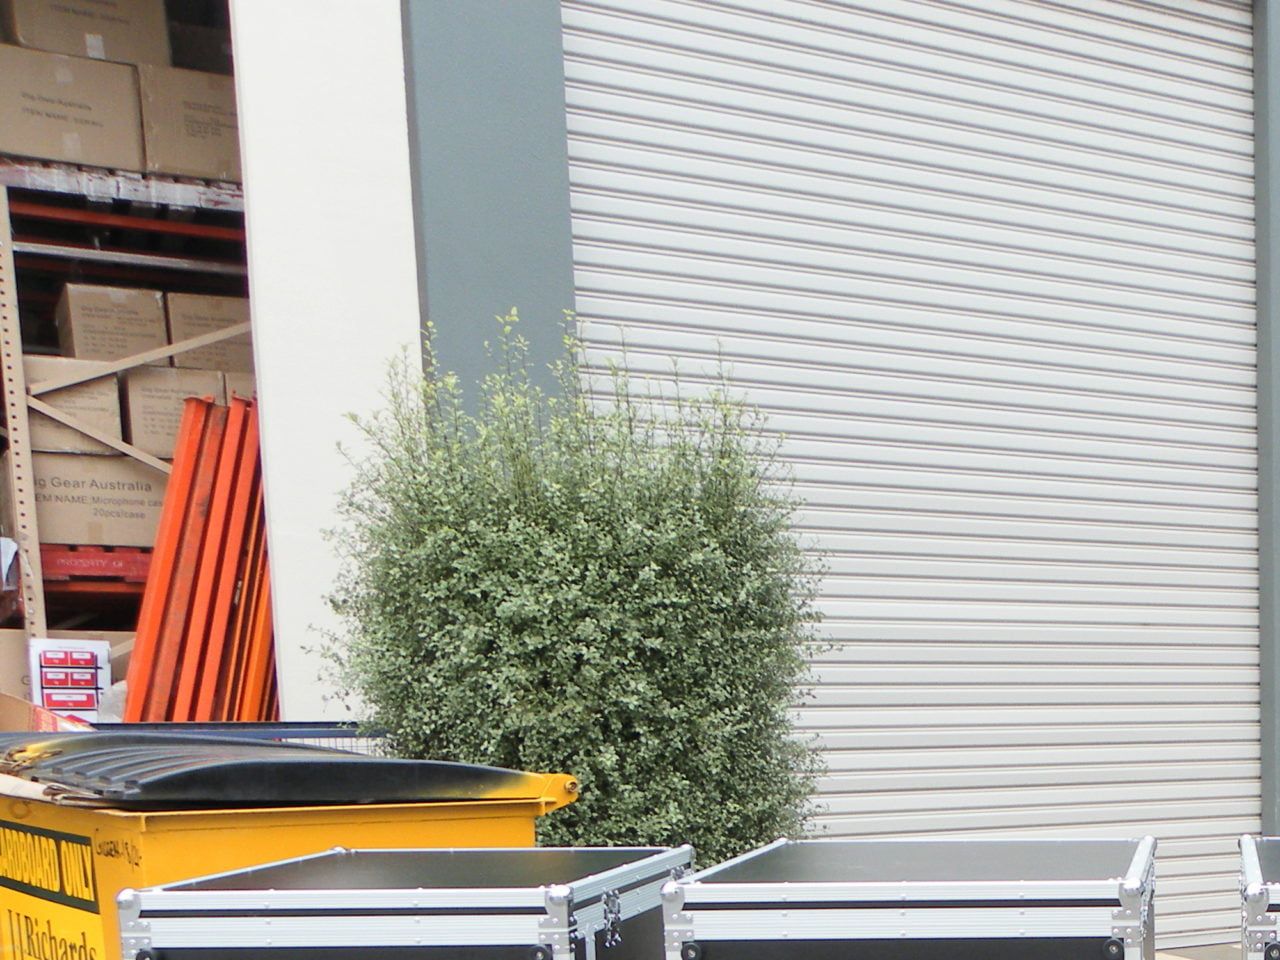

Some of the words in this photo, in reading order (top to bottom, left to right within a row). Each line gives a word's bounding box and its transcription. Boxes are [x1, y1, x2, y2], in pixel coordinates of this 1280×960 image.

[51, 476, 86, 489] Gear
[89, 478, 153, 493] Australia
[0, 826, 61, 893] ARDBOARD
[60, 839, 96, 902] ONLY
